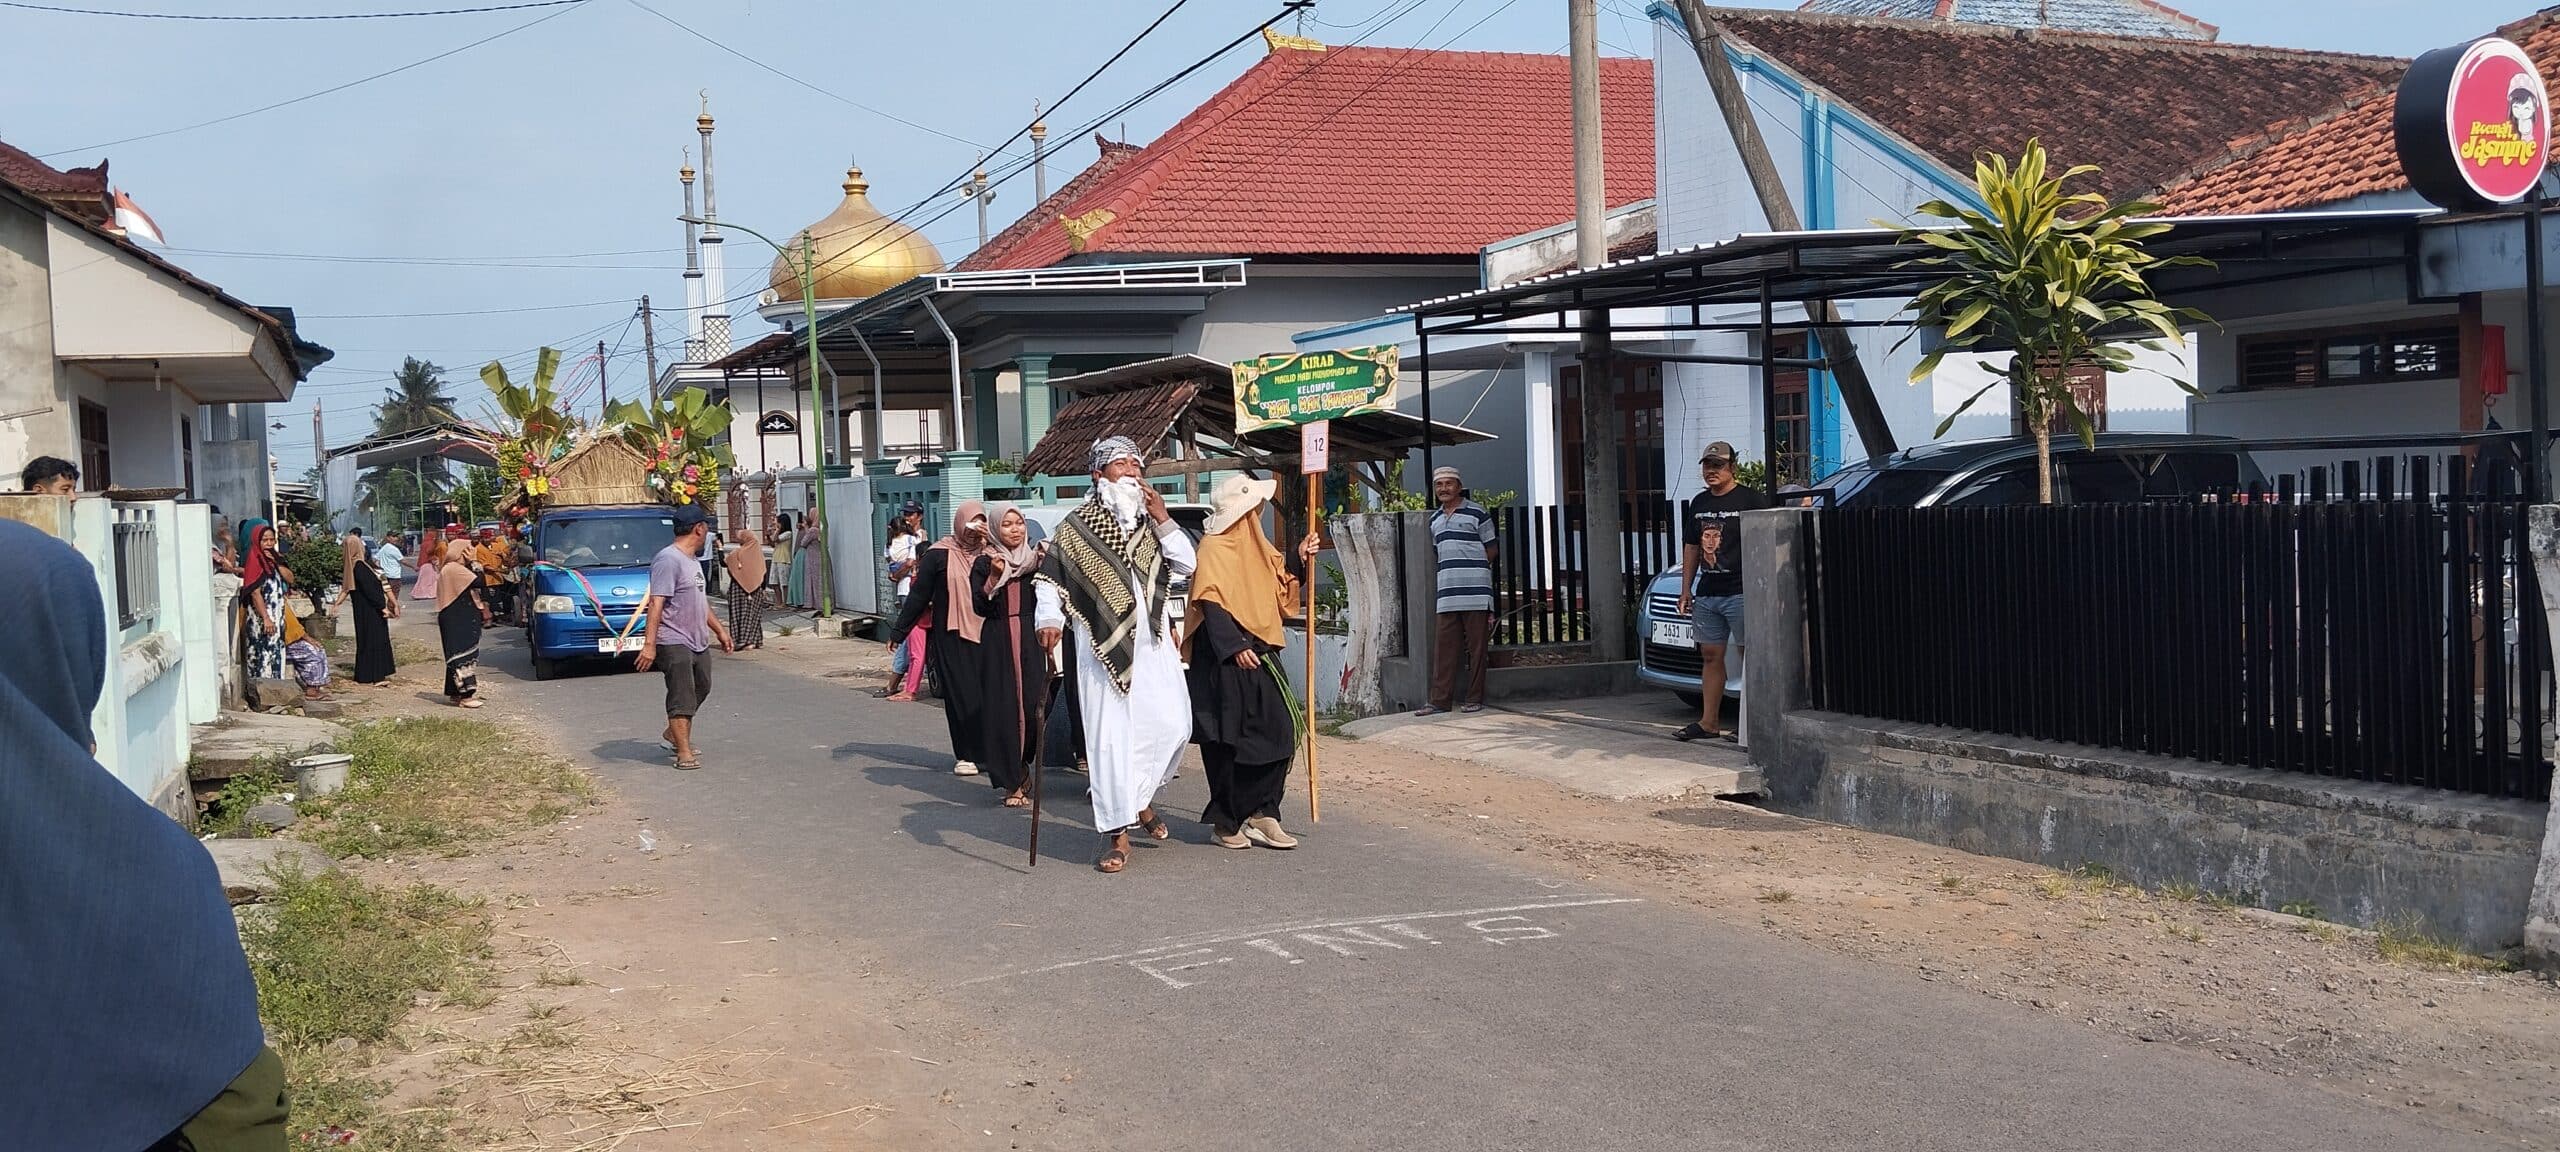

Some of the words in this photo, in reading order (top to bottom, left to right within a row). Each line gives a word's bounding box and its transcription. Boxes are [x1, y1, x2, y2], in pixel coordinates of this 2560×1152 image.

[2461, 134, 2537, 167] Jasmine
[1301, 354, 1335, 370] KIRAB
[1275, 373, 1296, 385] MAULID
[1297, 371, 1311, 382] NABI
[1345, 365, 1359, 376] SAW
[1297, 381, 1336, 395] KELOMPOK
[1314, 437, 1324, 453] 12
[1653, 622, 1658, 635] P
[1664, 623, 1680, 638] 1631
[601, 640, 610, 648] DK
